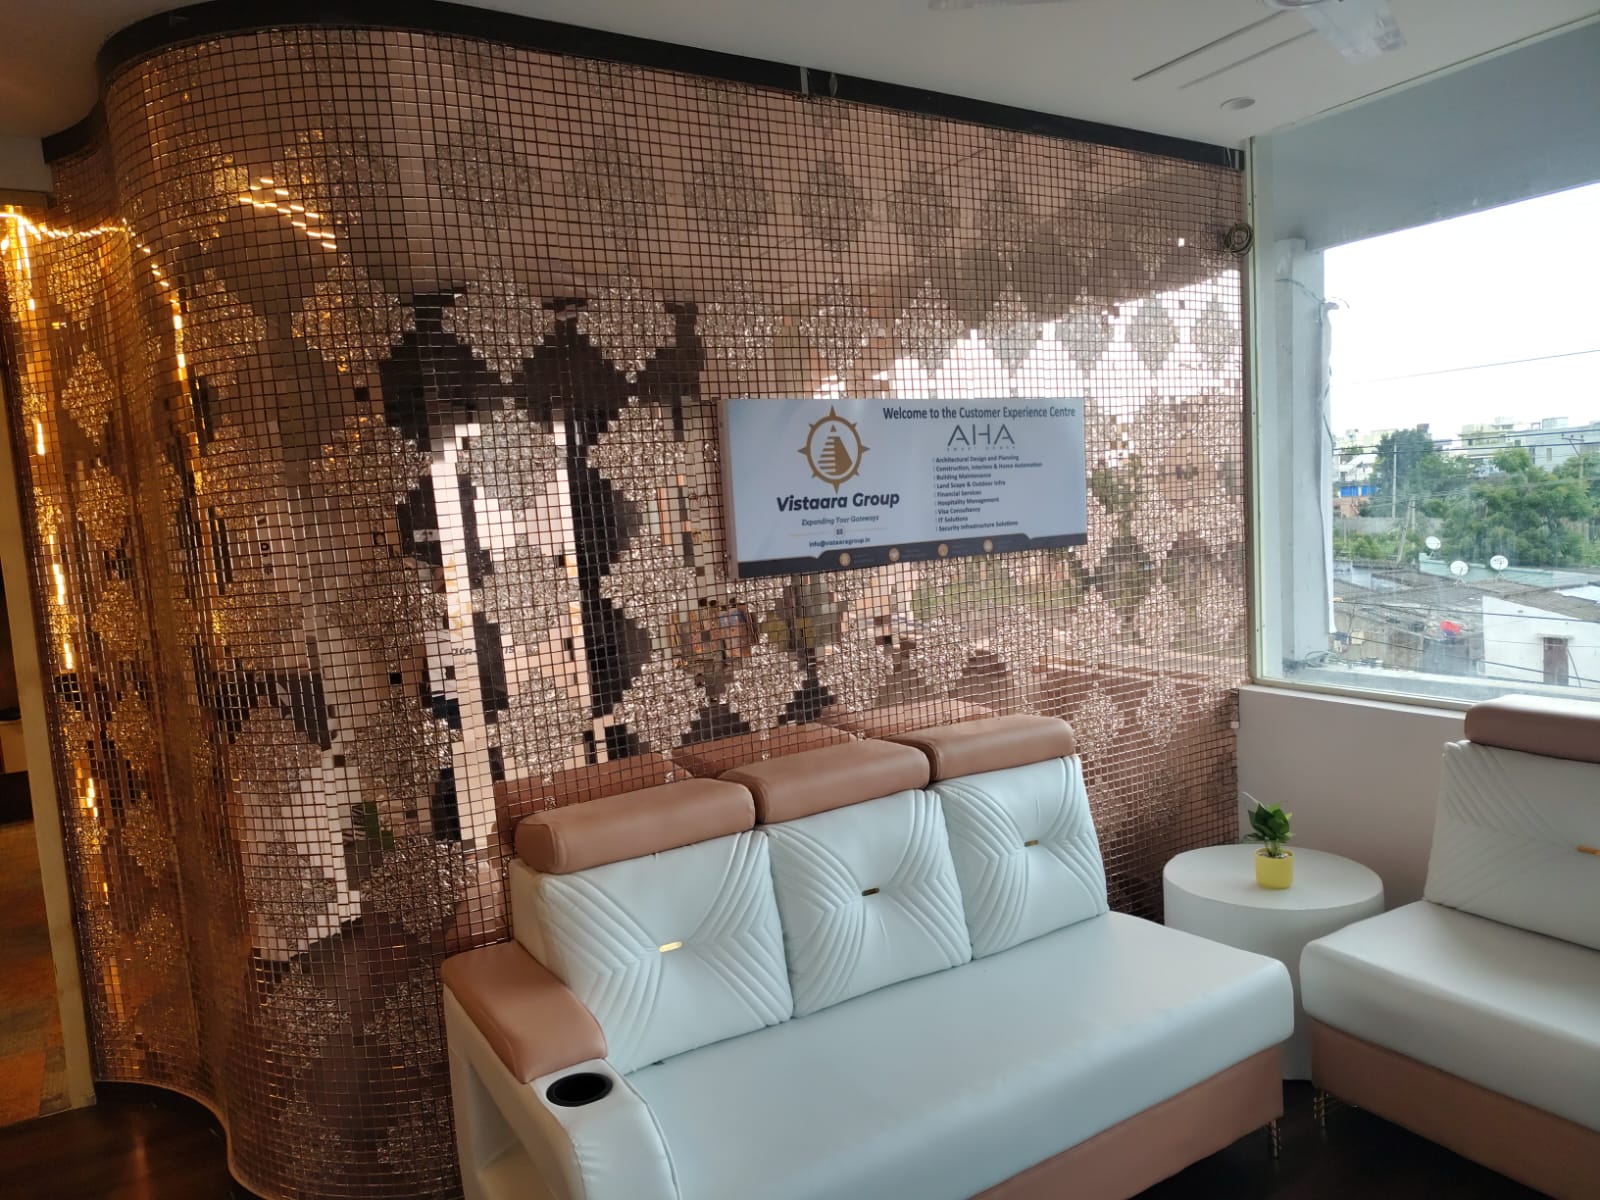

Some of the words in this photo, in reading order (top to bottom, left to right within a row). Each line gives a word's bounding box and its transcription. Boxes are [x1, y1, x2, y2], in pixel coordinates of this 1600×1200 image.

[883, 407, 927, 419] Welcome
[930, 408, 939, 418] to
[942, 407, 956, 418] the
[959, 407, 1000, 418] Customer
[1003, 406, 1047, 420] Experience
[1050, 407, 1076, 417] Centre
[948, 424, 1014, 446] AHA
[777, 495, 848, 511] Vistaara
[853, 493, 900, 508] Group
[802, 518, 834, 527] Expanding
[851, 515, 879, 523] Gateways
